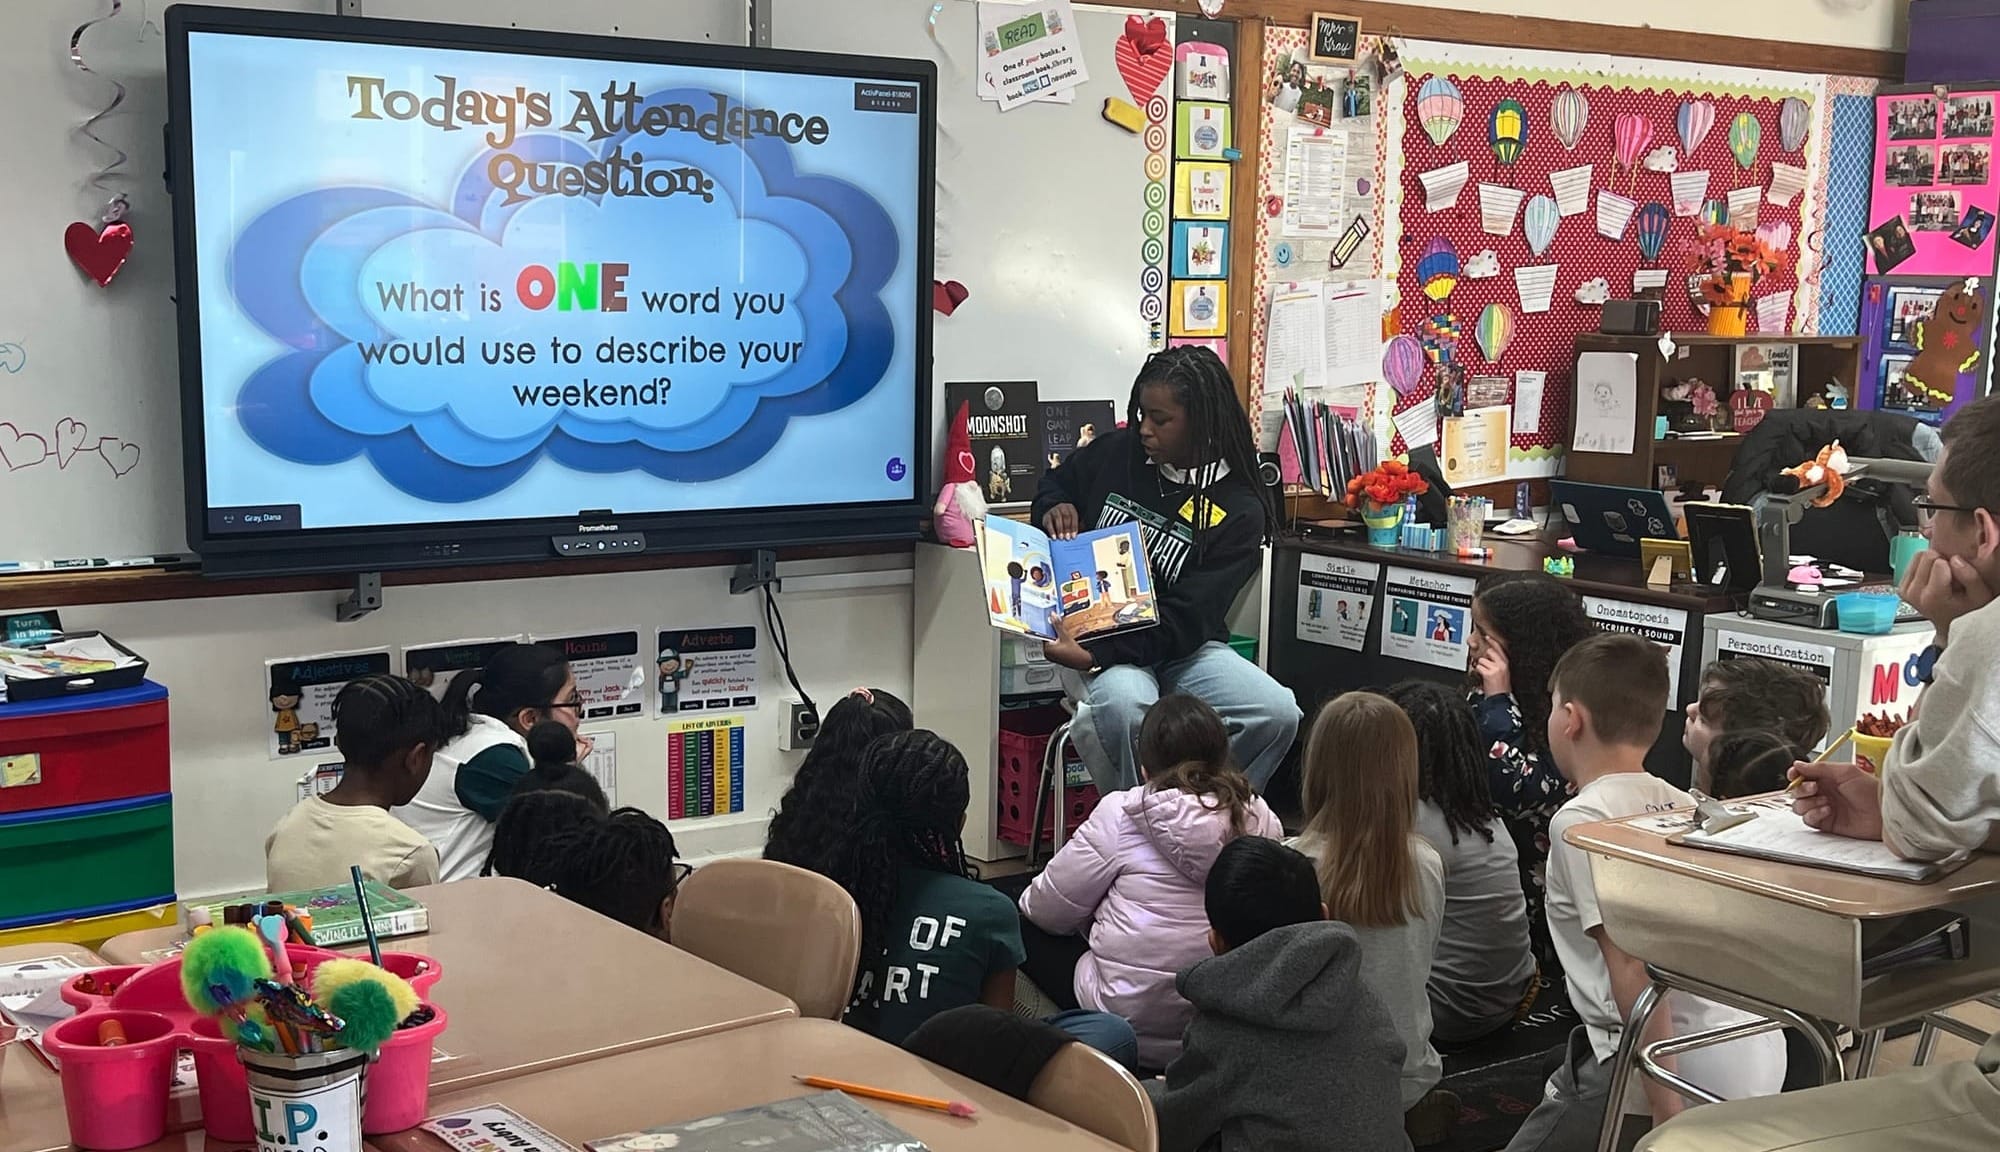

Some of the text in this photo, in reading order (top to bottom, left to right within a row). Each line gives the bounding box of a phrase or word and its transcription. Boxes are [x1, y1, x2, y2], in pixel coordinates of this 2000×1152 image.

[1004, 23, 1038, 45] READ
[1003, 61, 1017, 72] One
[1017, 58, 1025, 67] of
[1002, 69, 1036, 86] classroom
[347, 75, 830, 149] Today's Attendance
[487, 145, 715, 207] Question:
[376, 260, 786, 321] What is ONE word you
[357, 334, 804, 370] would use to describe your
[512, 377, 672, 408] weekend?
[1045, 406, 1071, 417] ONE
[966, 414, 1028, 435] MOONSHOT
[1046, 419, 1072, 431] GIANT
[1048, 432, 1073, 444] LEAP
[1326, 562, 1356, 576] Simile
[1409, 576, 1451, 591] Metaphor
[1596, 603, 1670, 625] Onomatopoeia
[13, 619, 41, 628] Turn
[681, 632, 735, 648] Adverbs
[1637, 627, 1643, 637] A
[1645, 629, 1675, 641] SOUND
[1727, 637, 1825, 664] Personification
[291, 661, 369, 680] Adjectives
[682, 722, 695, 730] LIST
[705, 719, 732, 728] ADVERBS
[314, 927, 347, 943] SWING
[909, 914, 967, 951] OF
[254, 1097, 328, 1145] I.P.
